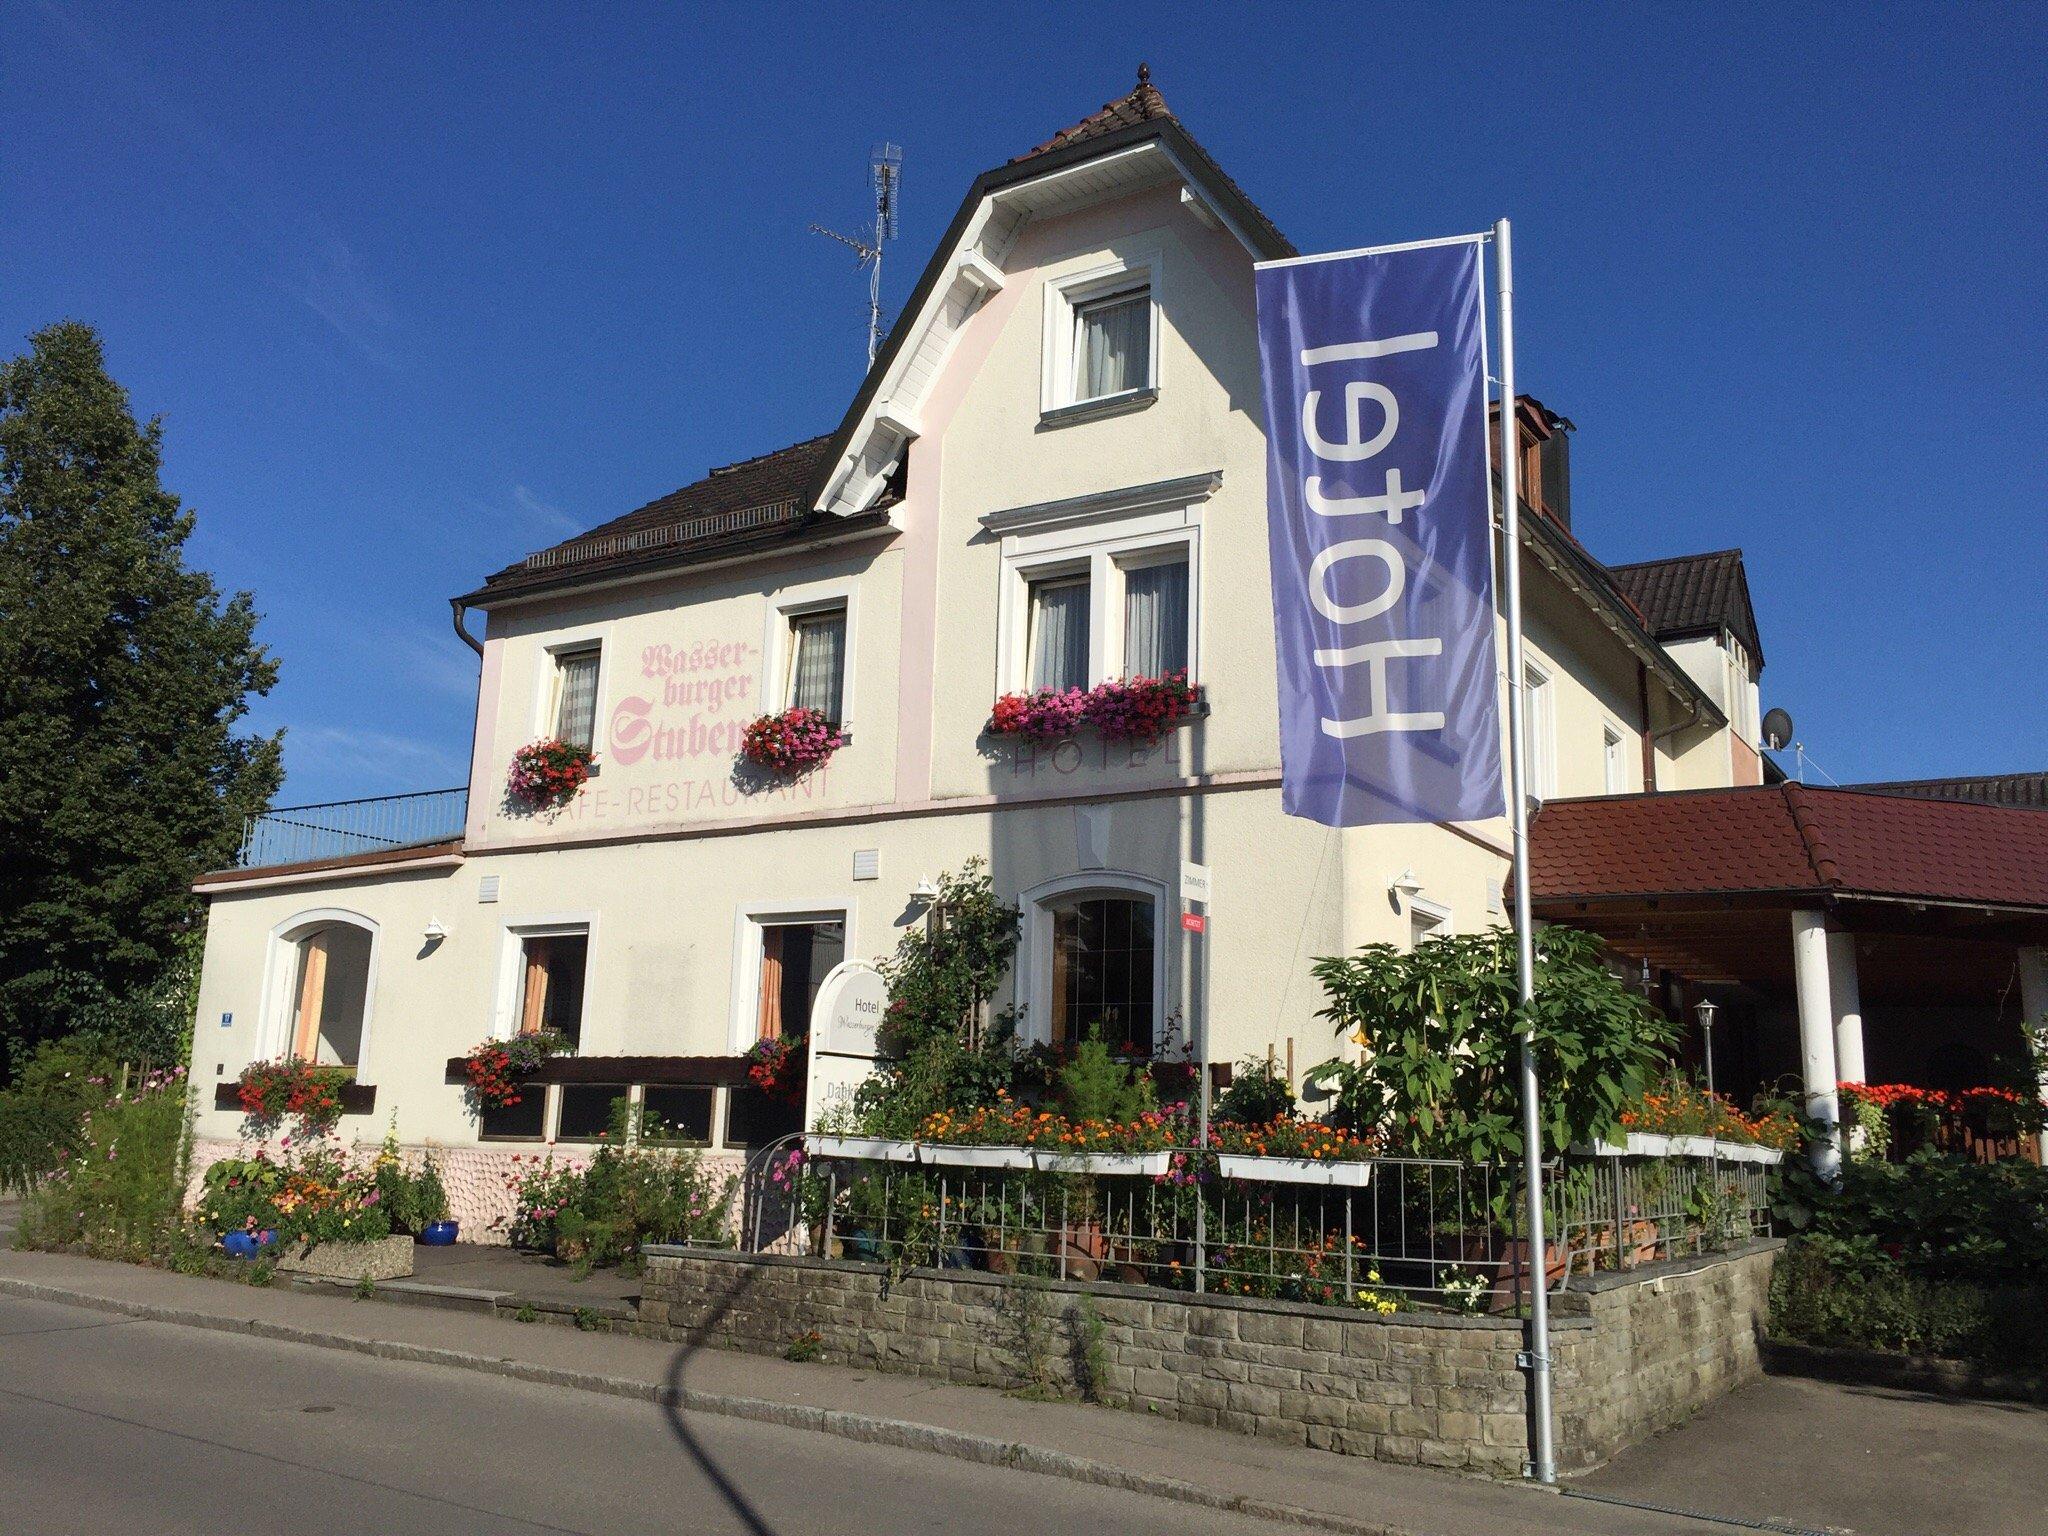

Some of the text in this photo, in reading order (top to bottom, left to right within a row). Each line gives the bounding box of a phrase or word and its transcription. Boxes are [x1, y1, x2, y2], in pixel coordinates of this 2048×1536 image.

[641, 638, 759, 679] Wasser-
[663, 673, 753, 713] burger
[610, 696, 748, 766] Stuben
[533, 766, 832, 824] AFE-RESTAUNT
[855, 998, 880, 1014] Hotel
